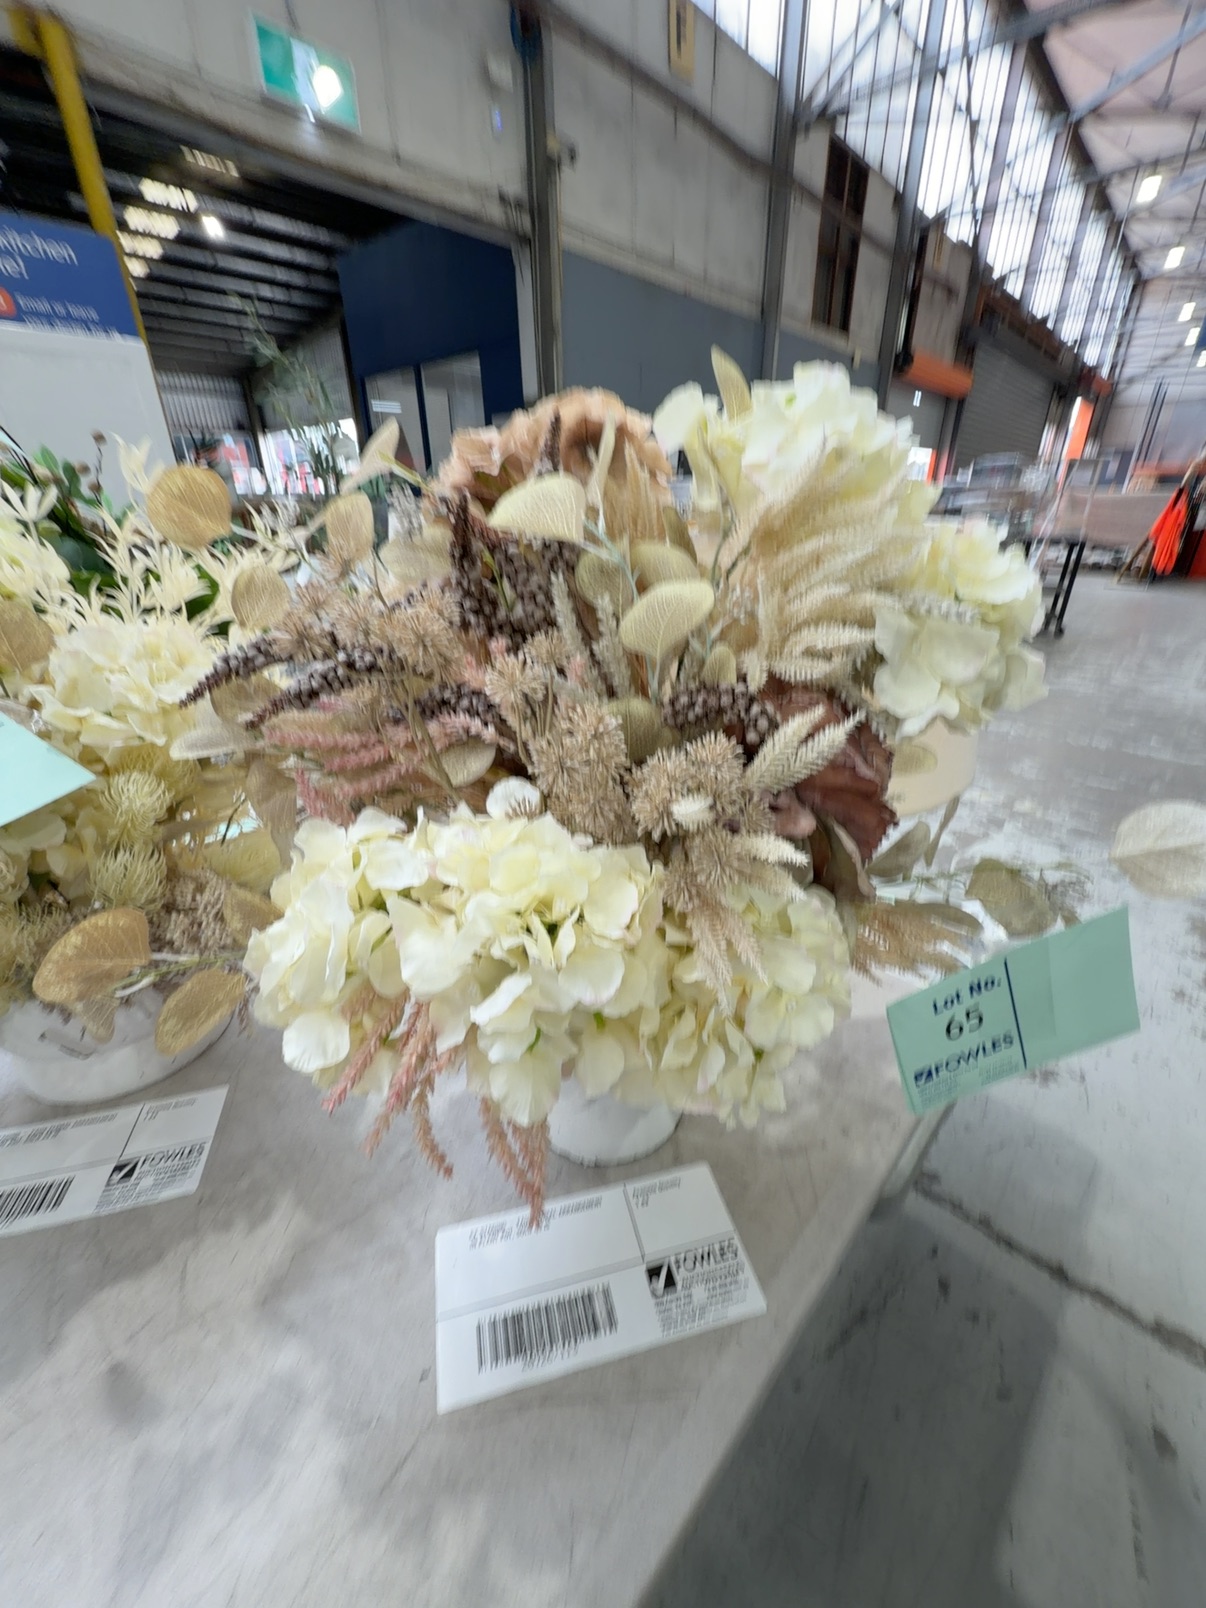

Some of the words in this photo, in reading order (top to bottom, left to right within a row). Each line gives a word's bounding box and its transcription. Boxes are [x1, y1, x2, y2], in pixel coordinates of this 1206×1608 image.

[932, 989, 963, 1016] Lot
[968, 975, 1001, 998] No.
[945, 1003, 984, 1041] 65
[933, 1030, 1014, 1079] FOWLES
[139, 1141, 207, 1170] FOWLES
[674, 1237, 738, 1275] FOWLES
